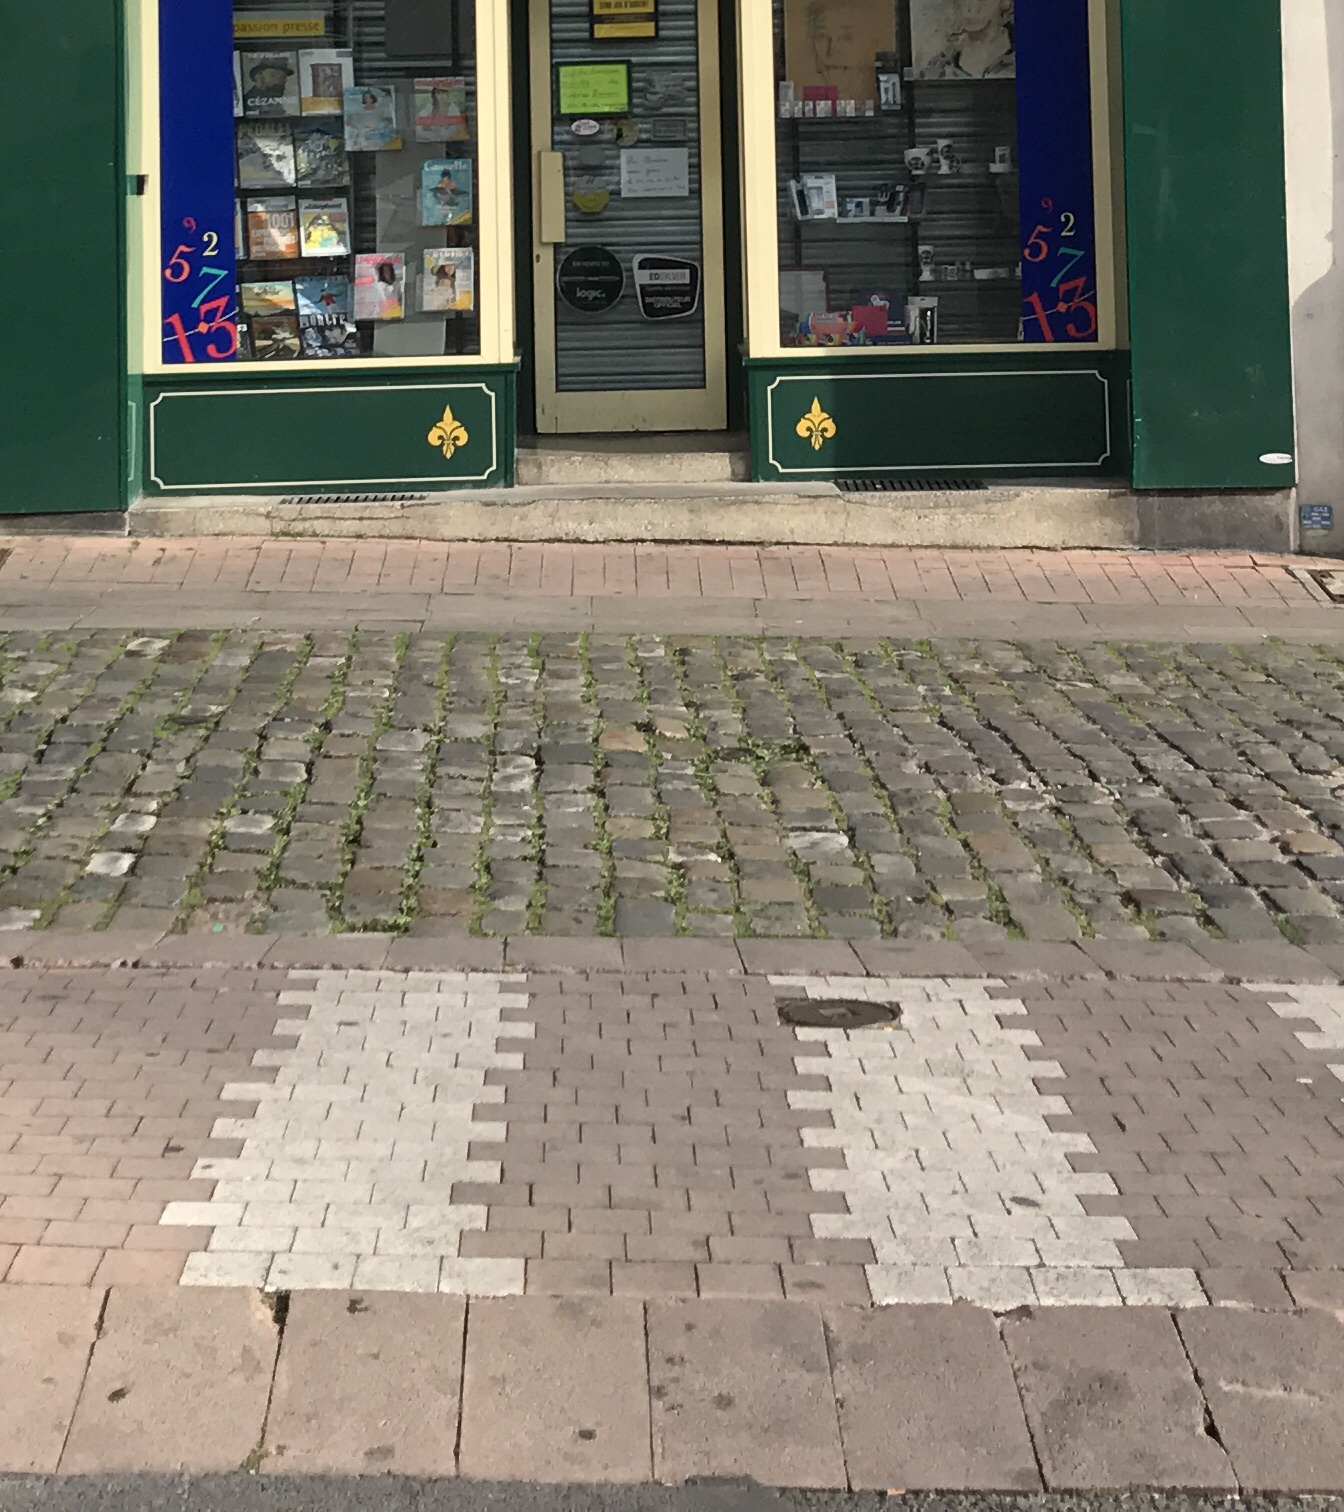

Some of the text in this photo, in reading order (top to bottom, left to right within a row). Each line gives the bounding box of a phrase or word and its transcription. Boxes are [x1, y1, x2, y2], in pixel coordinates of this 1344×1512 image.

[1041, 196, 1053, 213] 9
[182, 217, 197, 234] 9
[1060, 212, 1076, 237] 2
[202, 231, 219, 256] 2
[1023, 224, 1054, 262] 5
[165, 245, 197, 283] 5
[1050, 246, 1086, 288] 7
[191, 267, 229, 308] 7
